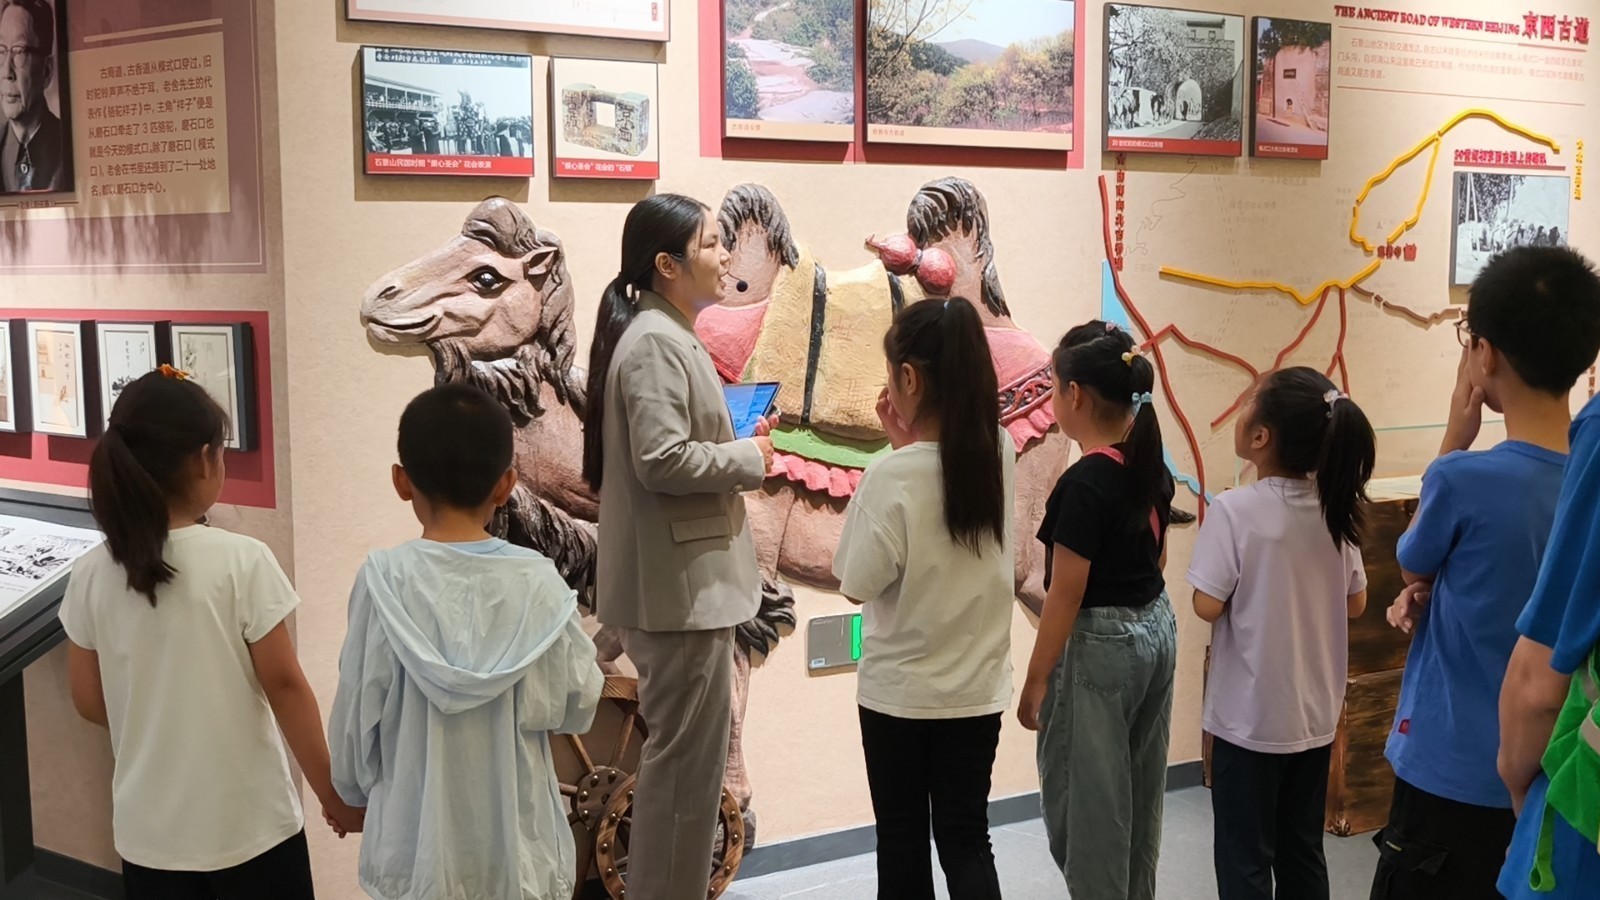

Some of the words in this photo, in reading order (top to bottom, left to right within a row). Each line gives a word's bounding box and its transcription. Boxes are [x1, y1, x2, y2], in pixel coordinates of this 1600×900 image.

[1334, 5, 1356, 19] THE
[1357, 8, 1400, 23] ANCIENT
[1401, 12, 1426, 26] ROAD
[1428, 16, 1441, 27] OF
[1441, 17, 1483, 32] WESTERN
[1484, 21, 1520, 35] BEIJING
[1522, 11, 1590, 45] 京西古道
[142, 122, 148, 135] 3
